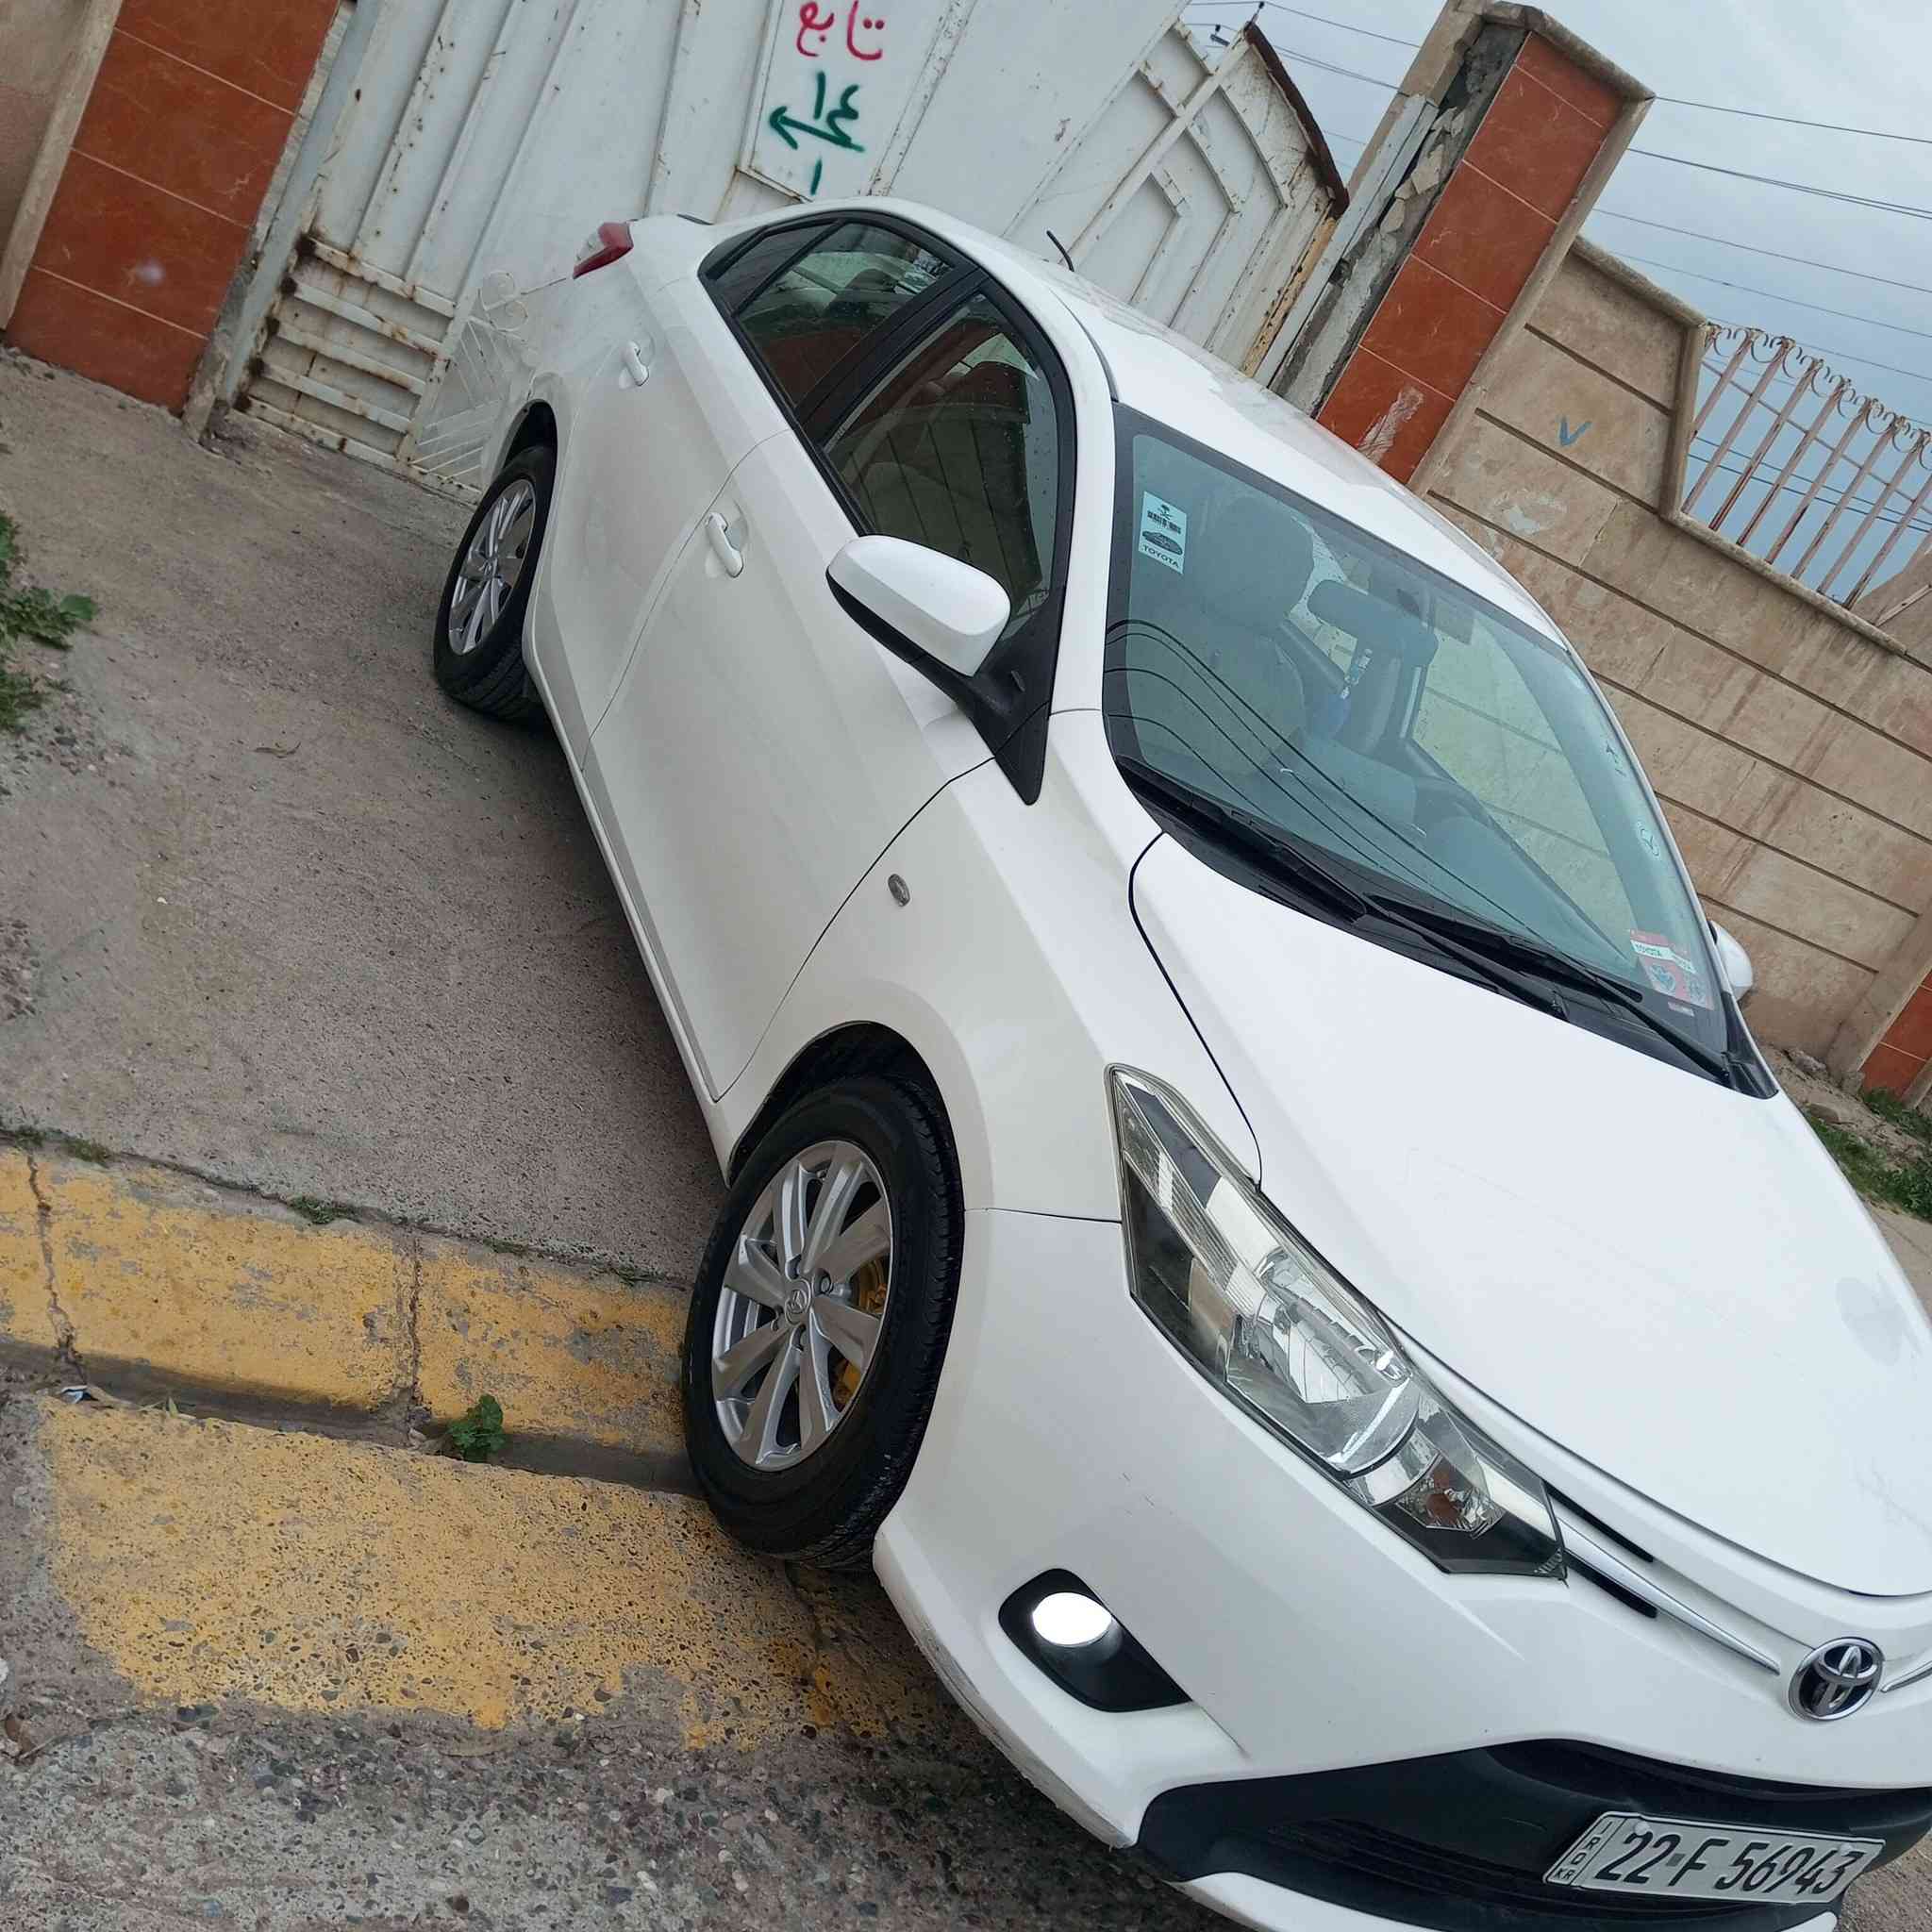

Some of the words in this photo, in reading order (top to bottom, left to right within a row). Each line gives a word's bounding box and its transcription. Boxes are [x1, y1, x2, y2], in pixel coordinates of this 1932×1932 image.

[796, 0, 885, 60] تابع
[1142, 544, 1179, 568] TOYOTA
[1593, 1830, 1682, 1885] 22
[1667, 1838, 1731, 1887] F
[1714, 1840, 1868, 1895] 56943
